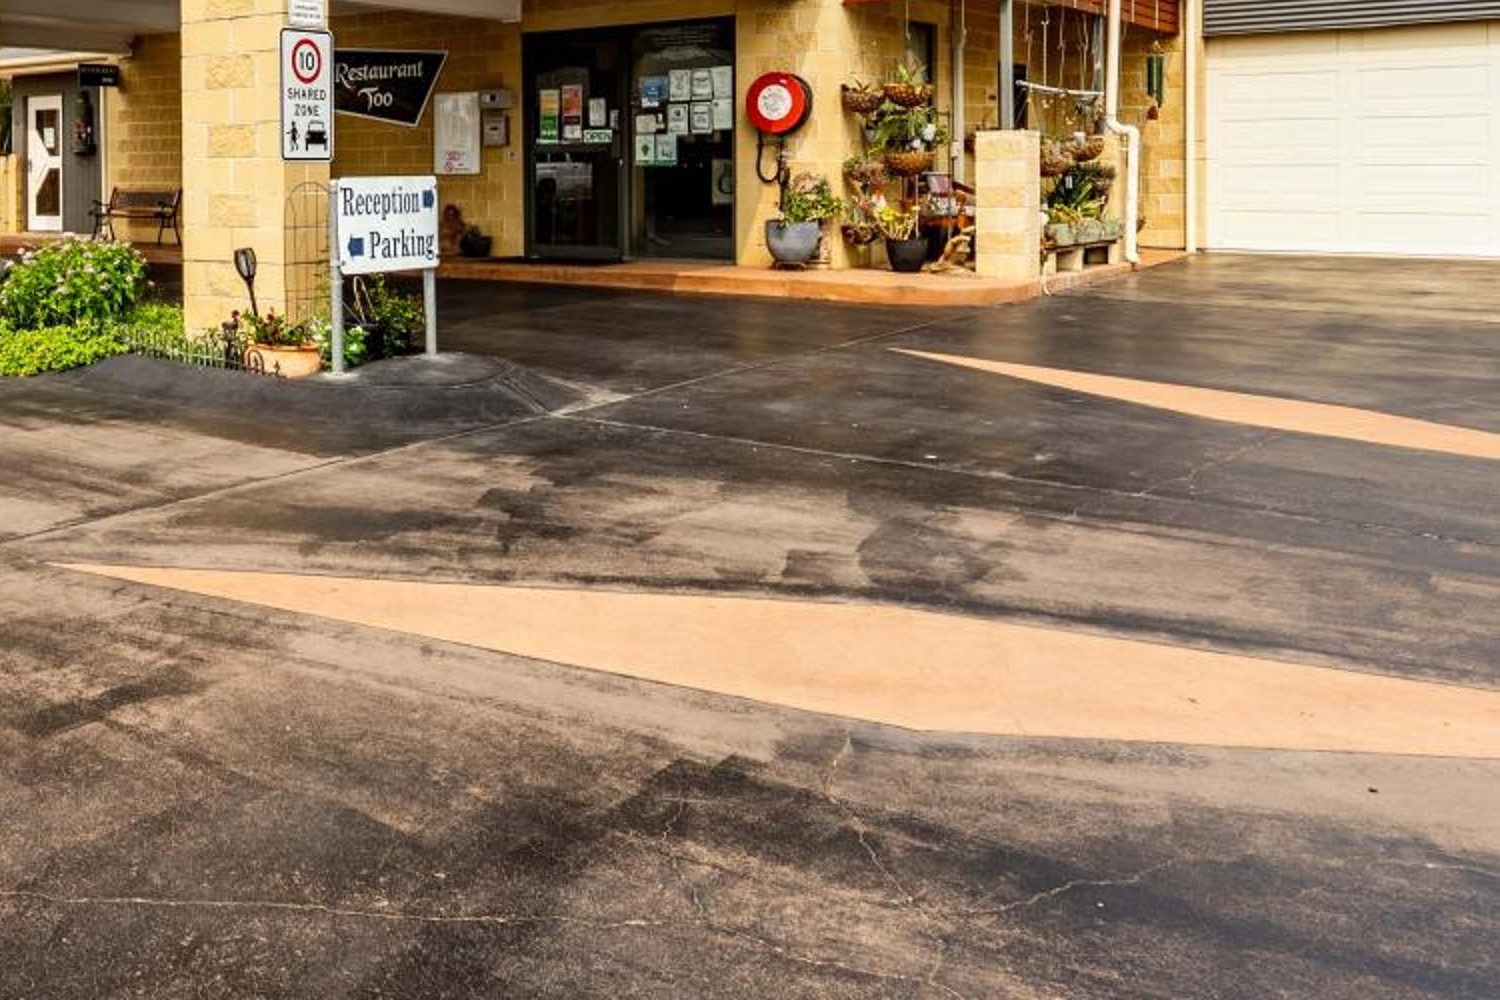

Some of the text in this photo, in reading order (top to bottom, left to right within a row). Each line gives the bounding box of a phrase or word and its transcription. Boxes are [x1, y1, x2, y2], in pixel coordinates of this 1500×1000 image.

[299, 51, 315, 71] 10
[335, 61, 424, 89] Restaurant
[287, 87, 327, 101] SHARED
[357, 86, 394, 112] Too
[294, 103, 320, 117] ZONE
[340, 186, 420, 221] Reception
[369, 228, 435, 261] Parking
